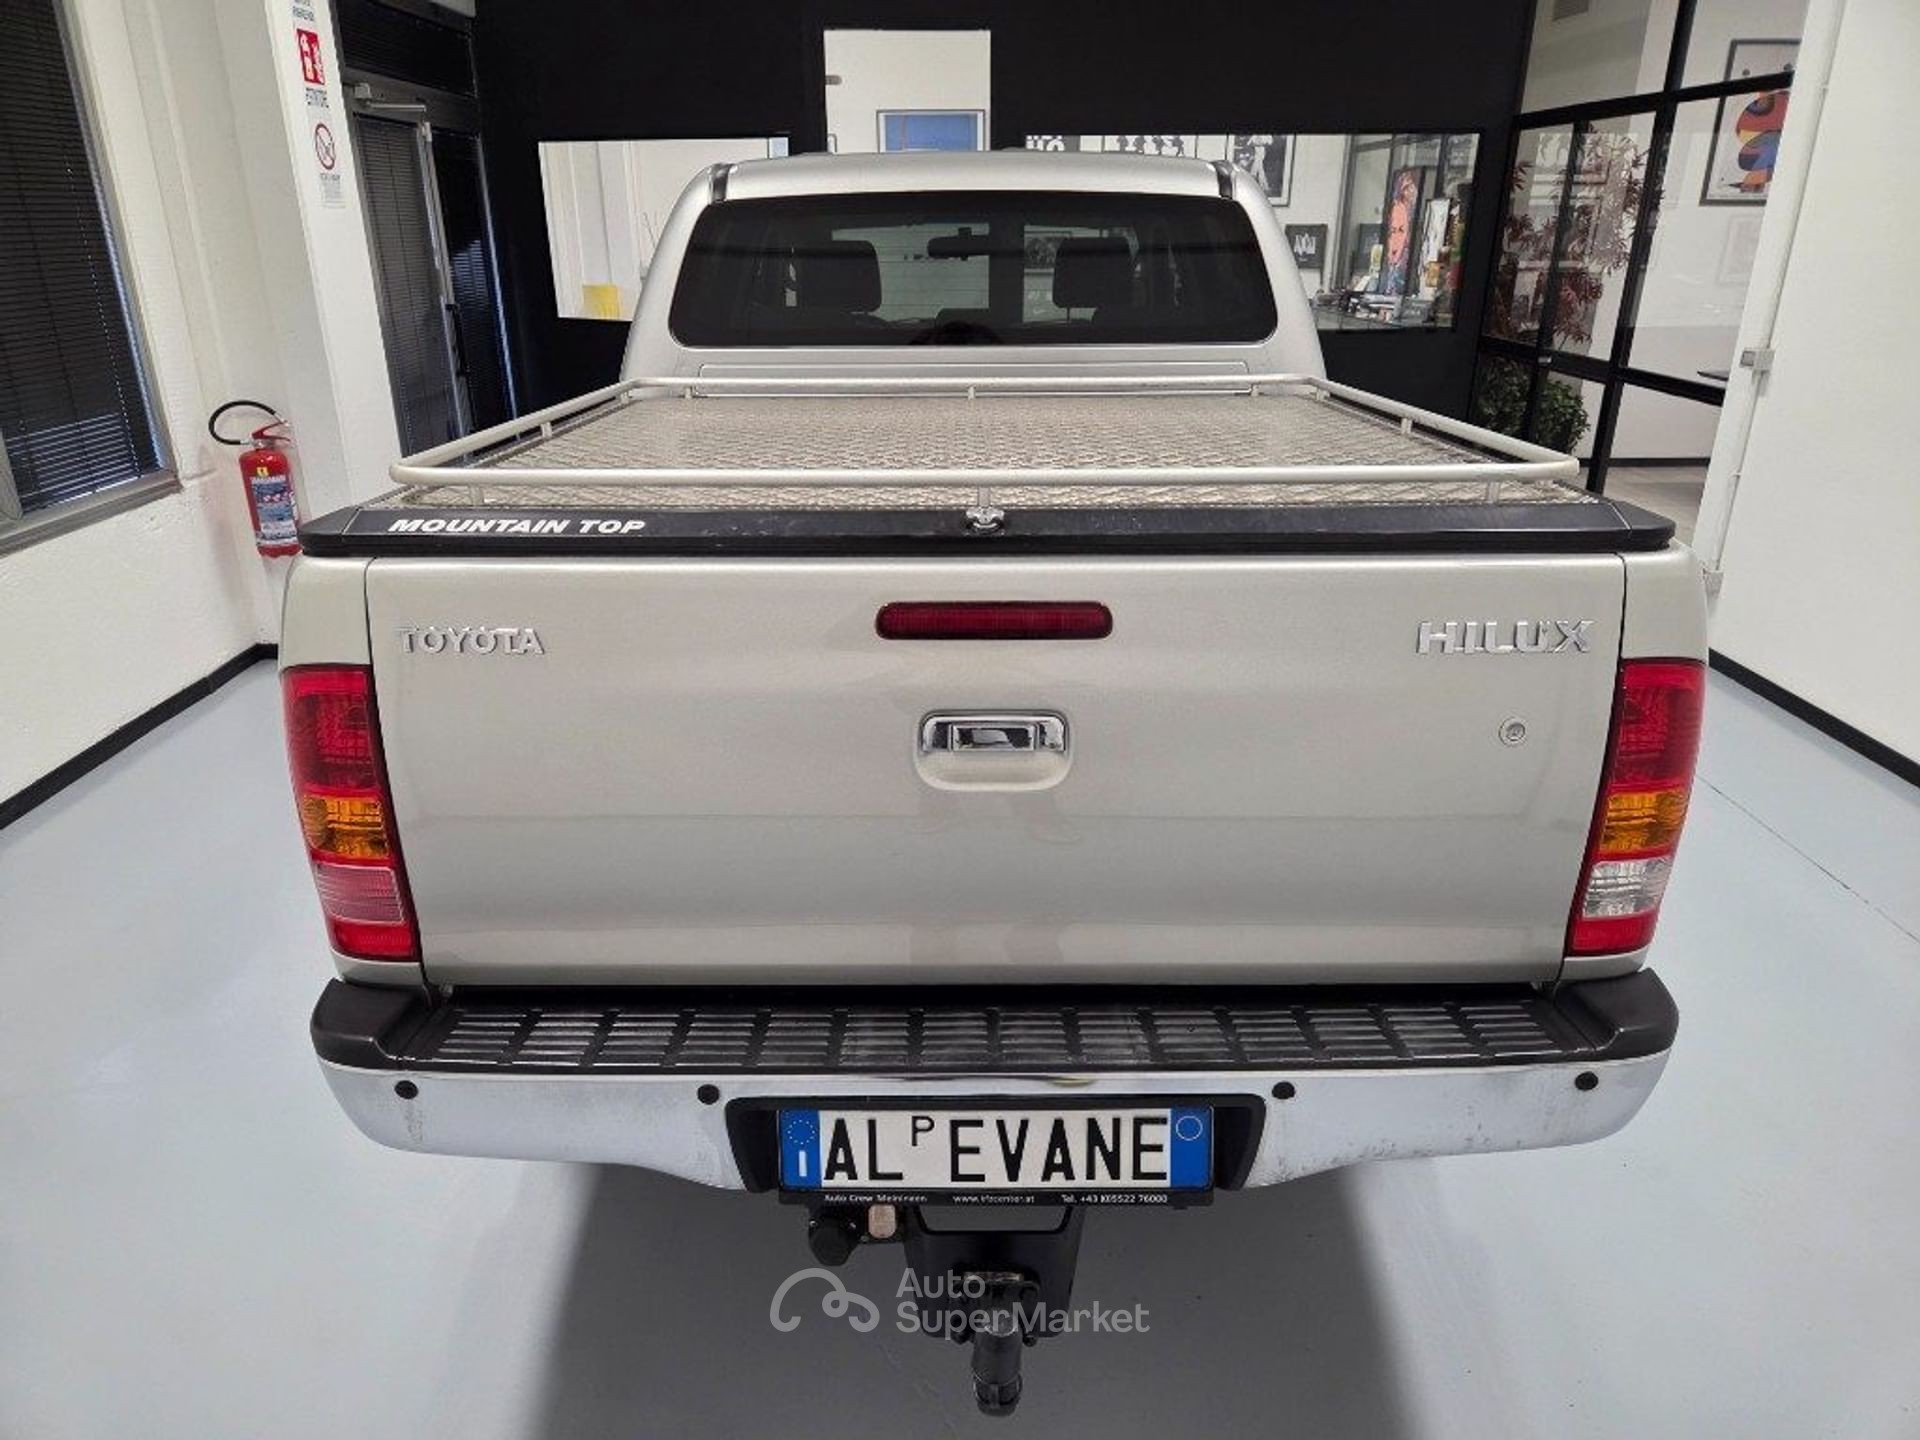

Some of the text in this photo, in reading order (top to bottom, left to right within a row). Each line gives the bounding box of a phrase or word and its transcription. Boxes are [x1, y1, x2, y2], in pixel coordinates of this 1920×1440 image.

[388, 518, 646, 534] MOUNTAIN TOP
[399, 626, 545, 655] TOYOTA
[1415, 619, 1595, 654] HILUX
[823, 1116, 904, 1181] AL
[911, 1116, 935, 1147] P
[949, 1116, 1169, 1182] EVANE
